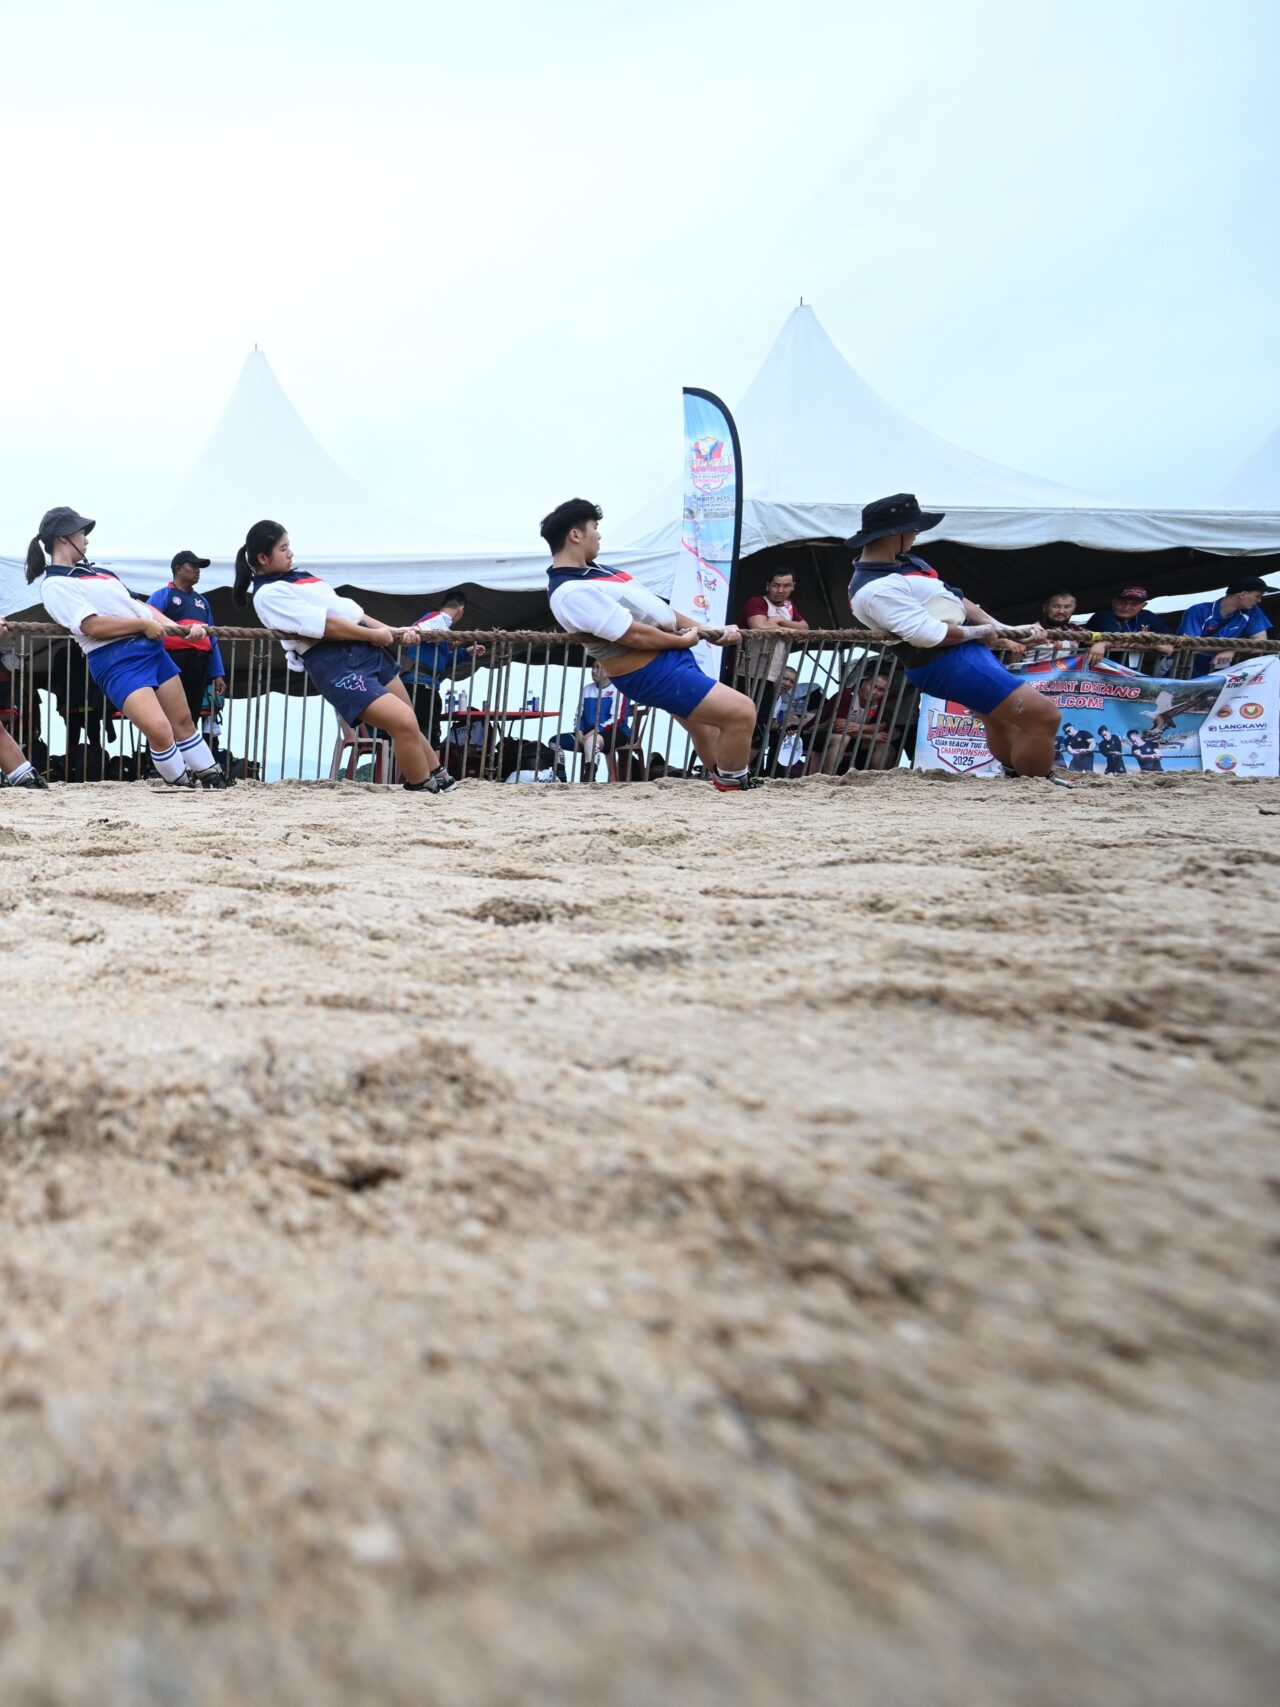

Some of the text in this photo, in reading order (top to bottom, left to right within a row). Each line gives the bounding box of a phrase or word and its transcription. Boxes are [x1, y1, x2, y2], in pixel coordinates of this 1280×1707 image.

[928, 709, 987, 740] LANGK
[948, 740, 969, 748] BEACH
[953, 755, 974, 766] 2025
